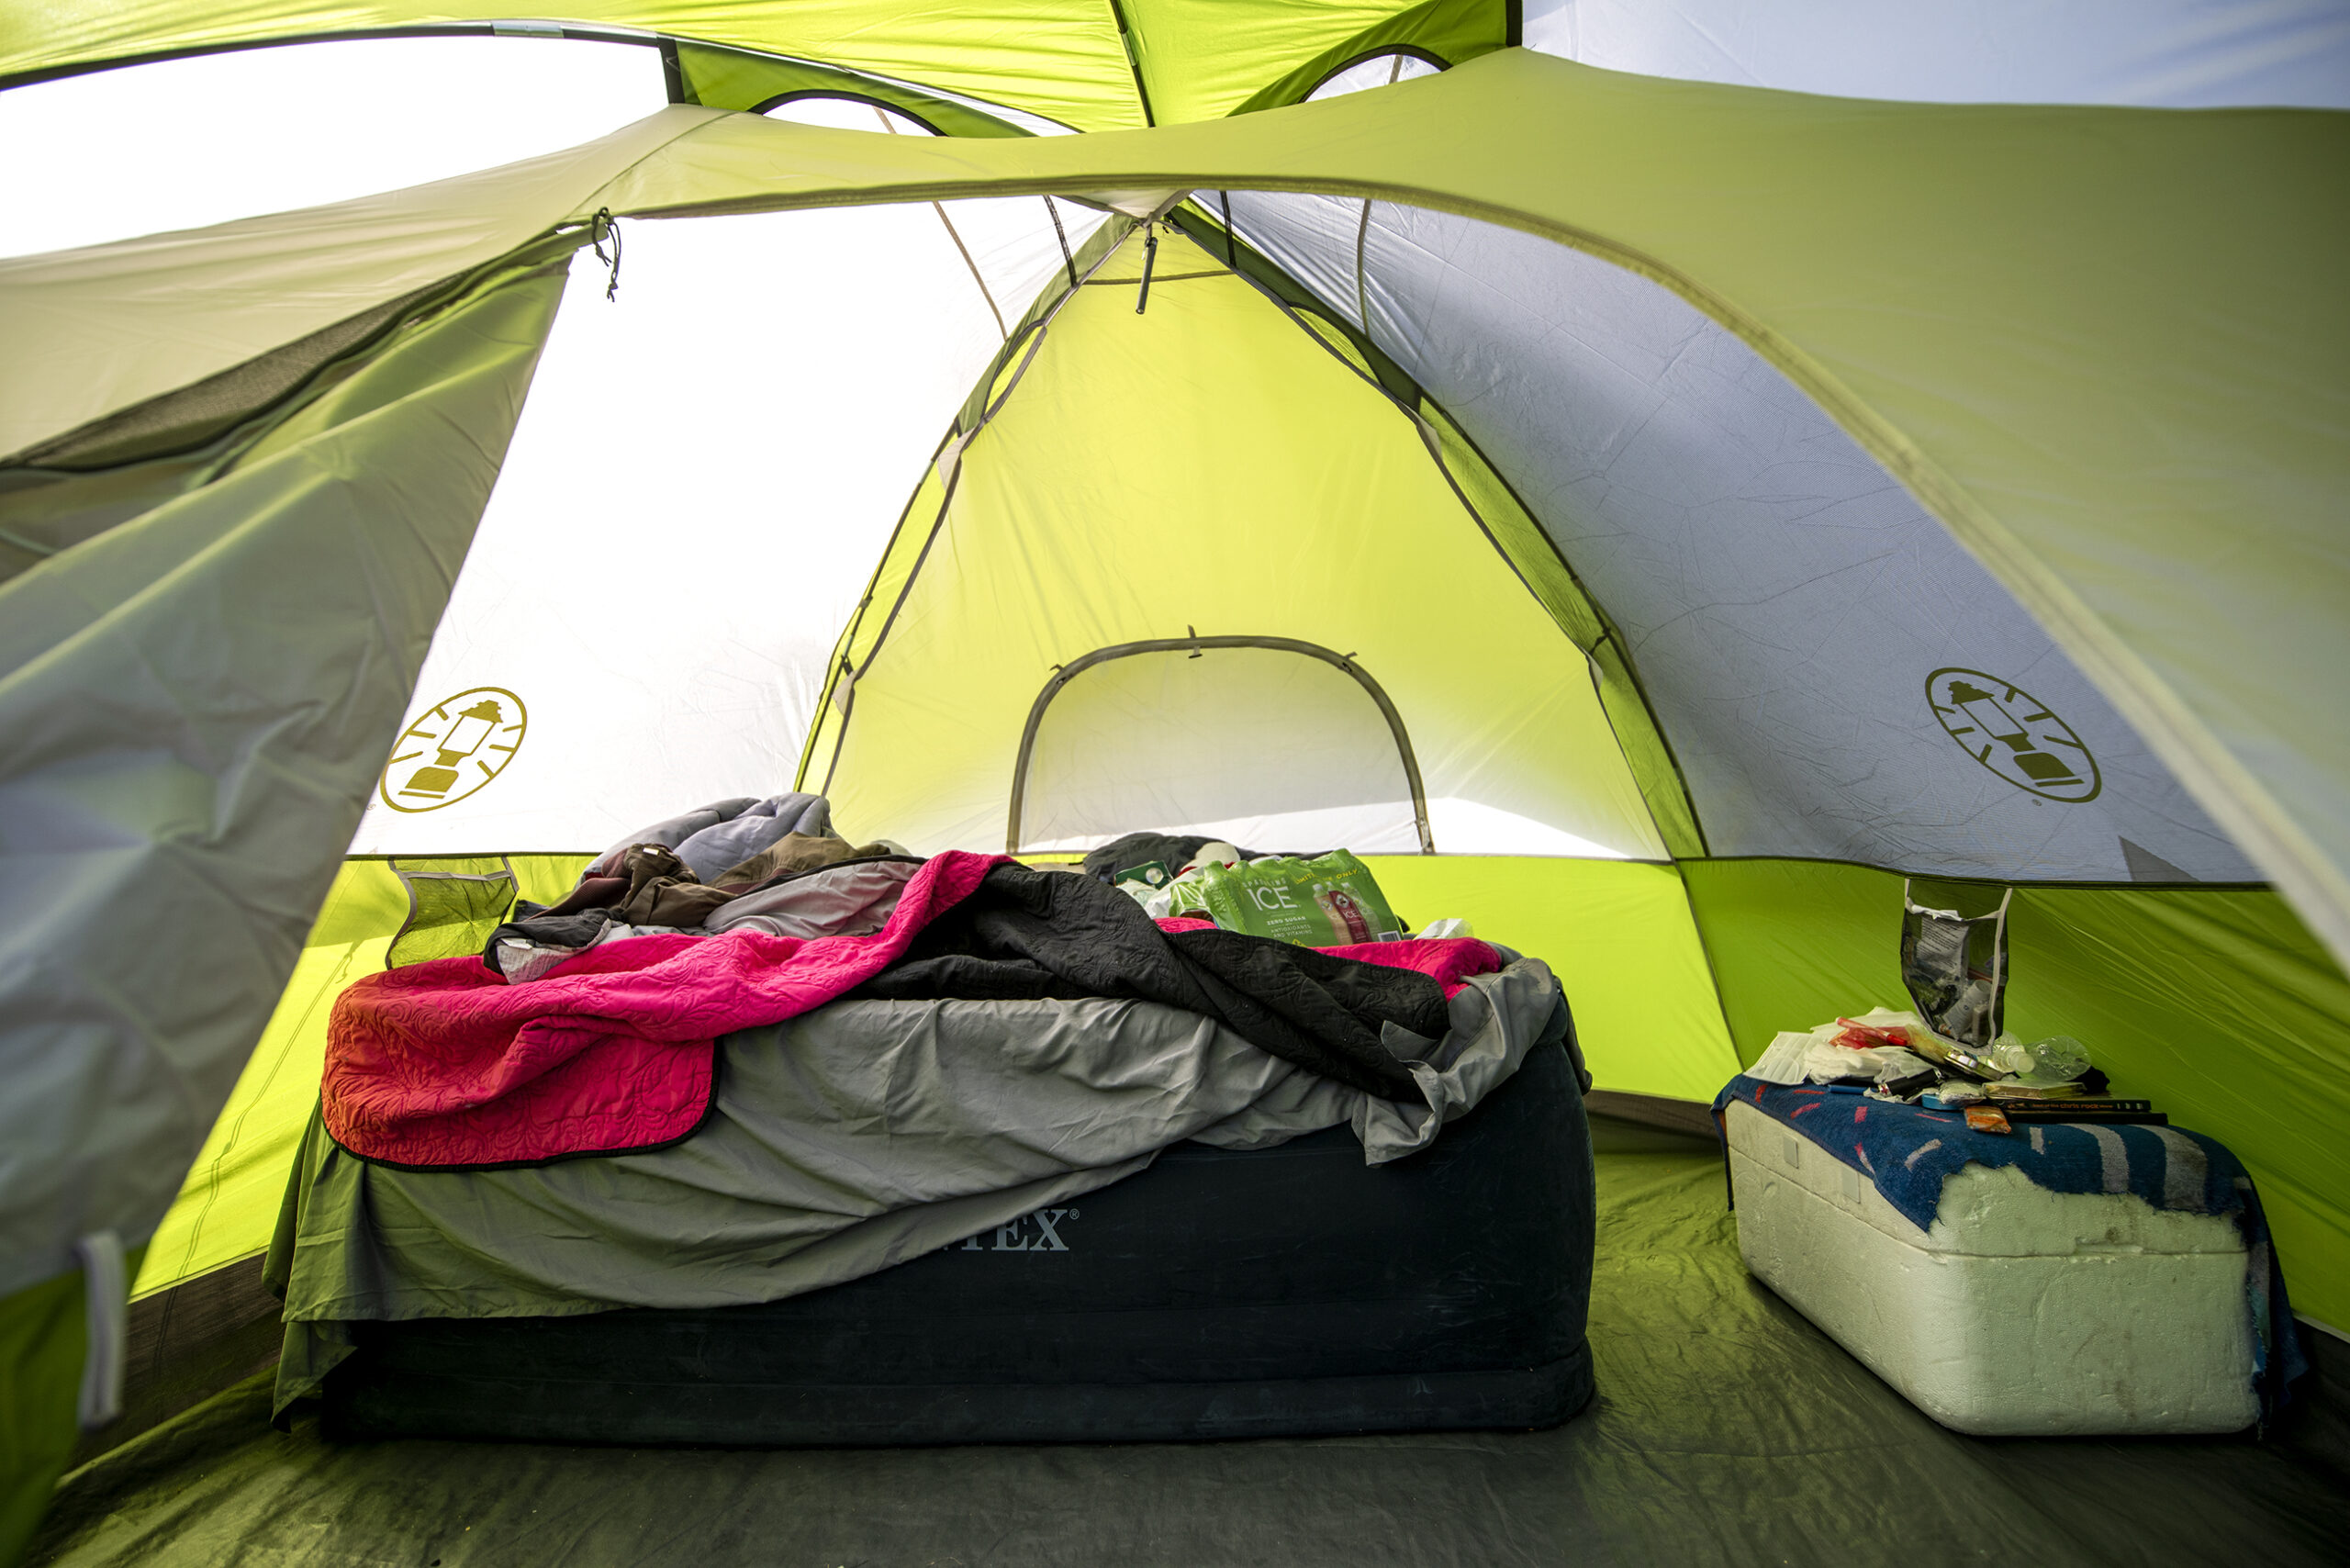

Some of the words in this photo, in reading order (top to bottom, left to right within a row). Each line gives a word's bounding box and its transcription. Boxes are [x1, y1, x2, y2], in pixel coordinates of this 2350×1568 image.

[1336, 868, 1358, 879] ONLY
[1247, 886, 1299, 911] ICE
[1343, 910, 1359, 919] ICE
[1270, 924, 1311, 934] ANTIOXIDANTS
